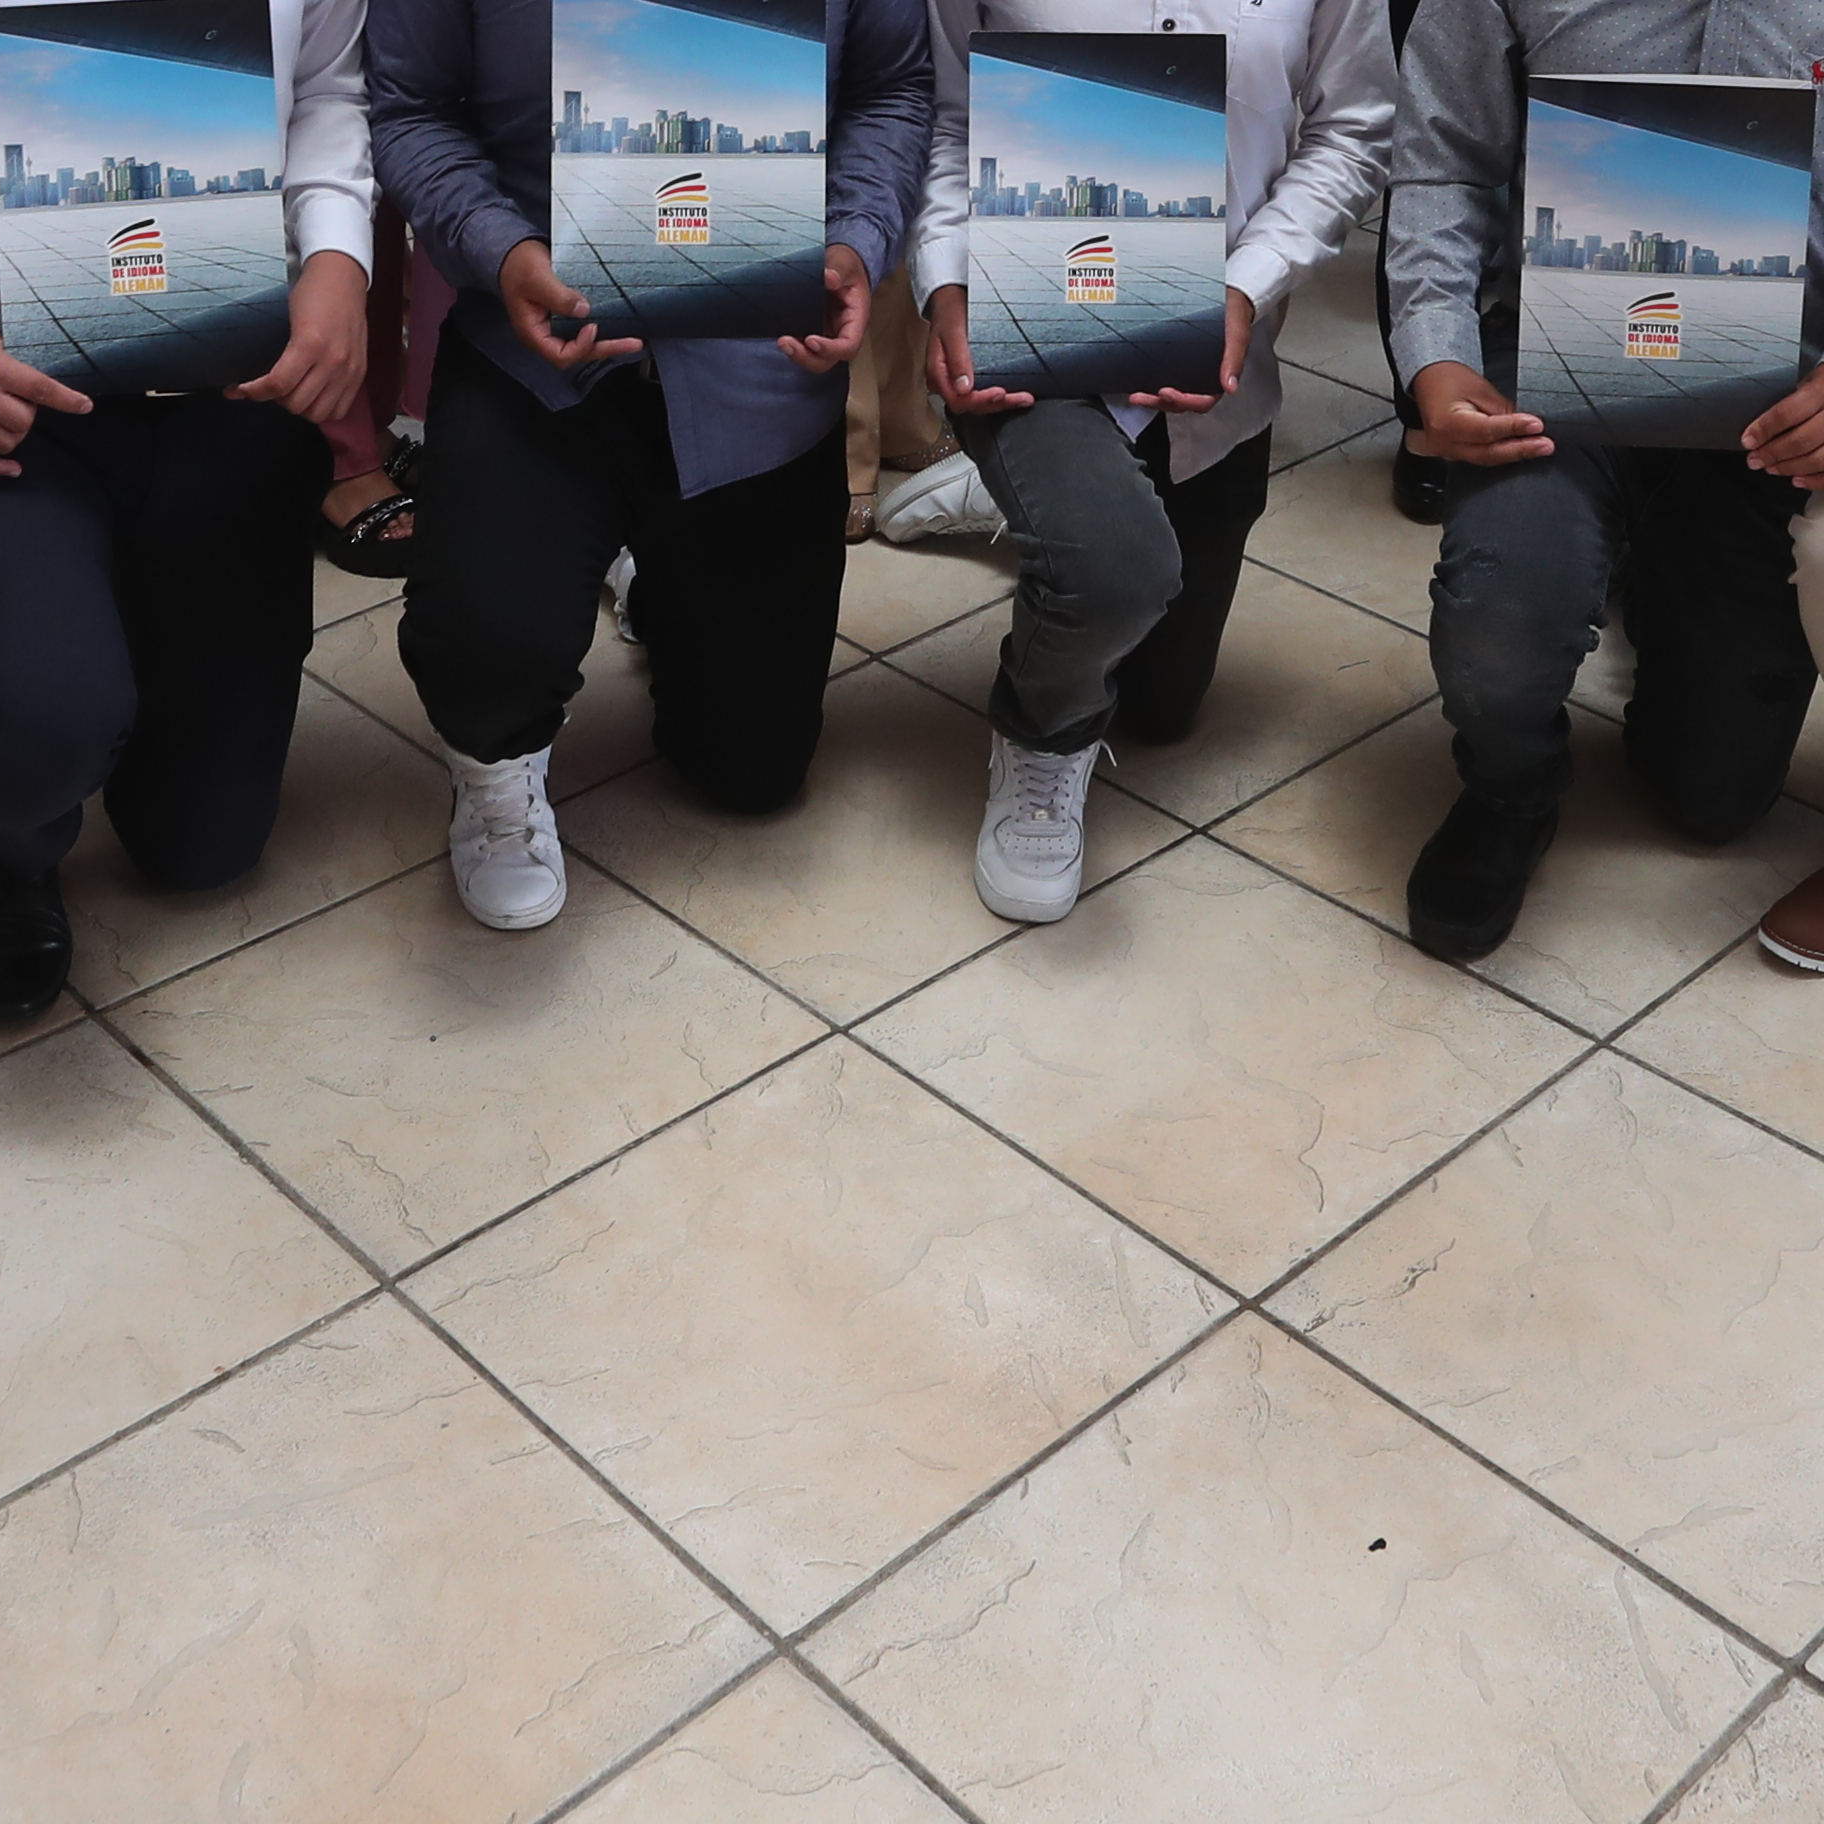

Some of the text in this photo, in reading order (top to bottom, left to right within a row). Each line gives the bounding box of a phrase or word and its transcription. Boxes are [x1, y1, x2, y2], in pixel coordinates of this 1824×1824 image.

[658, 207, 707, 217] INSTITUTO
[658, 218, 709, 227] DE IDIOMA
[111, 254, 163, 267] INSTITUTO
[112, 266, 165, 278] DE IDIOMA
[1068, 268, 1114, 277] INSTITUTO
[1068, 278, 1115, 287] DE IDIOMA
[1628, 323, 1679, 334] INSTITUTO
[1628, 333, 1679, 344] DE IDIOMA
